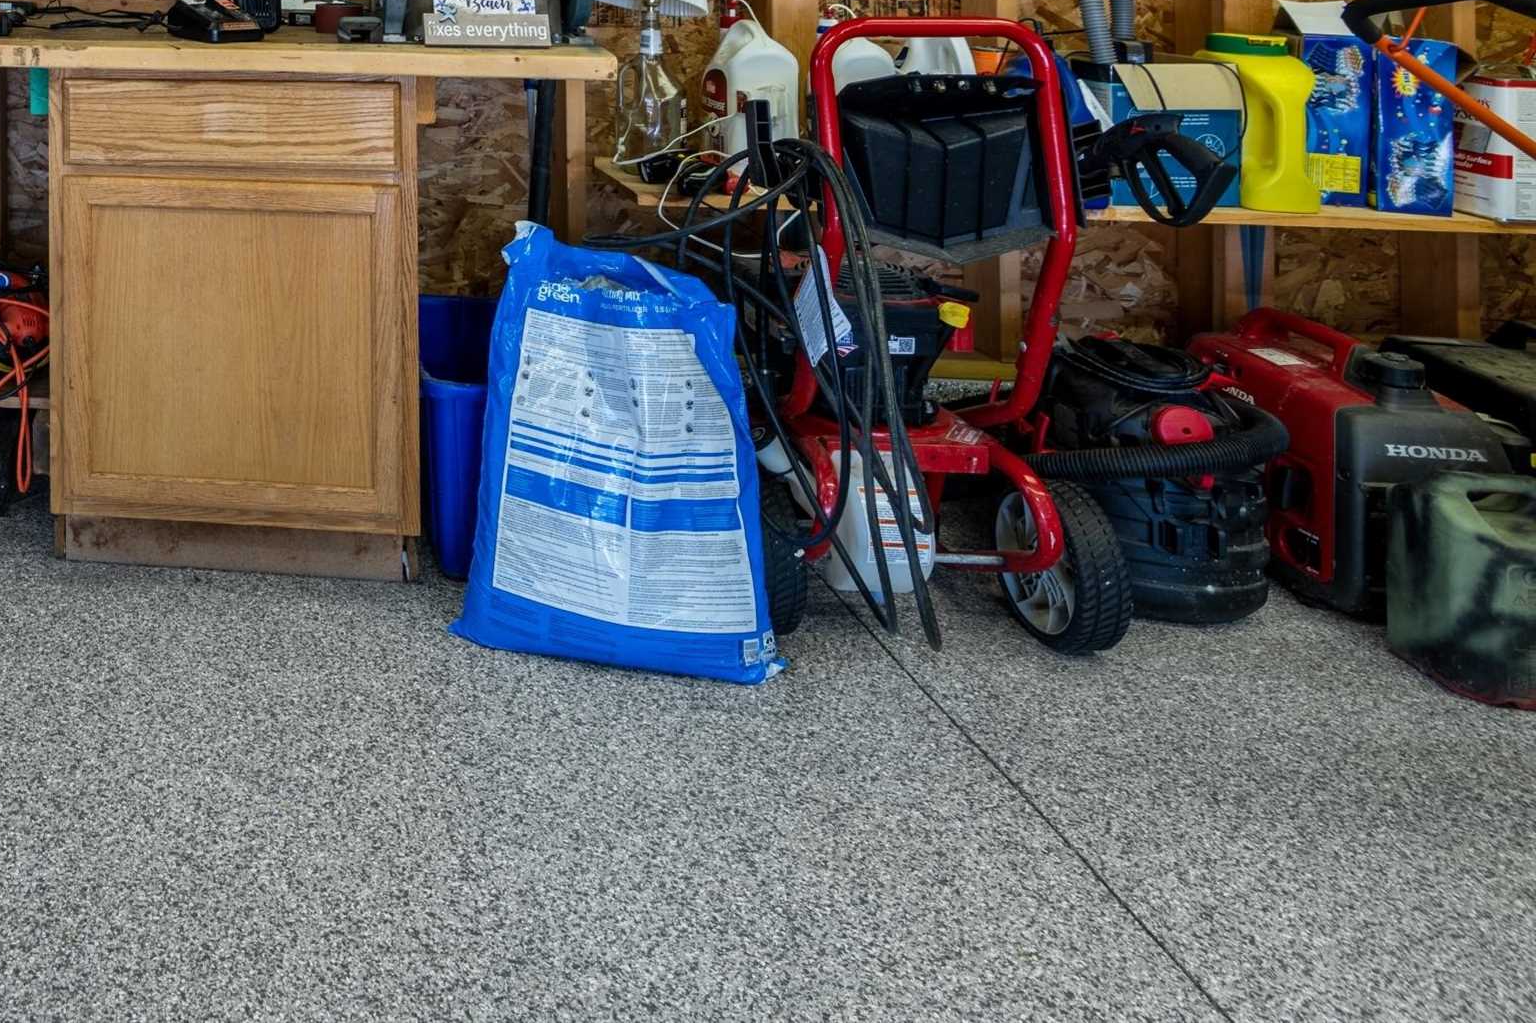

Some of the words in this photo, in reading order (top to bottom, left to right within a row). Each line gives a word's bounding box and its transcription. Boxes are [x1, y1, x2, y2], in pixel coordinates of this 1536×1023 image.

[466, 21, 548, 42] everything
[536, 284, 580, 304] green
[1384, 444, 1489, 463] HONDA
